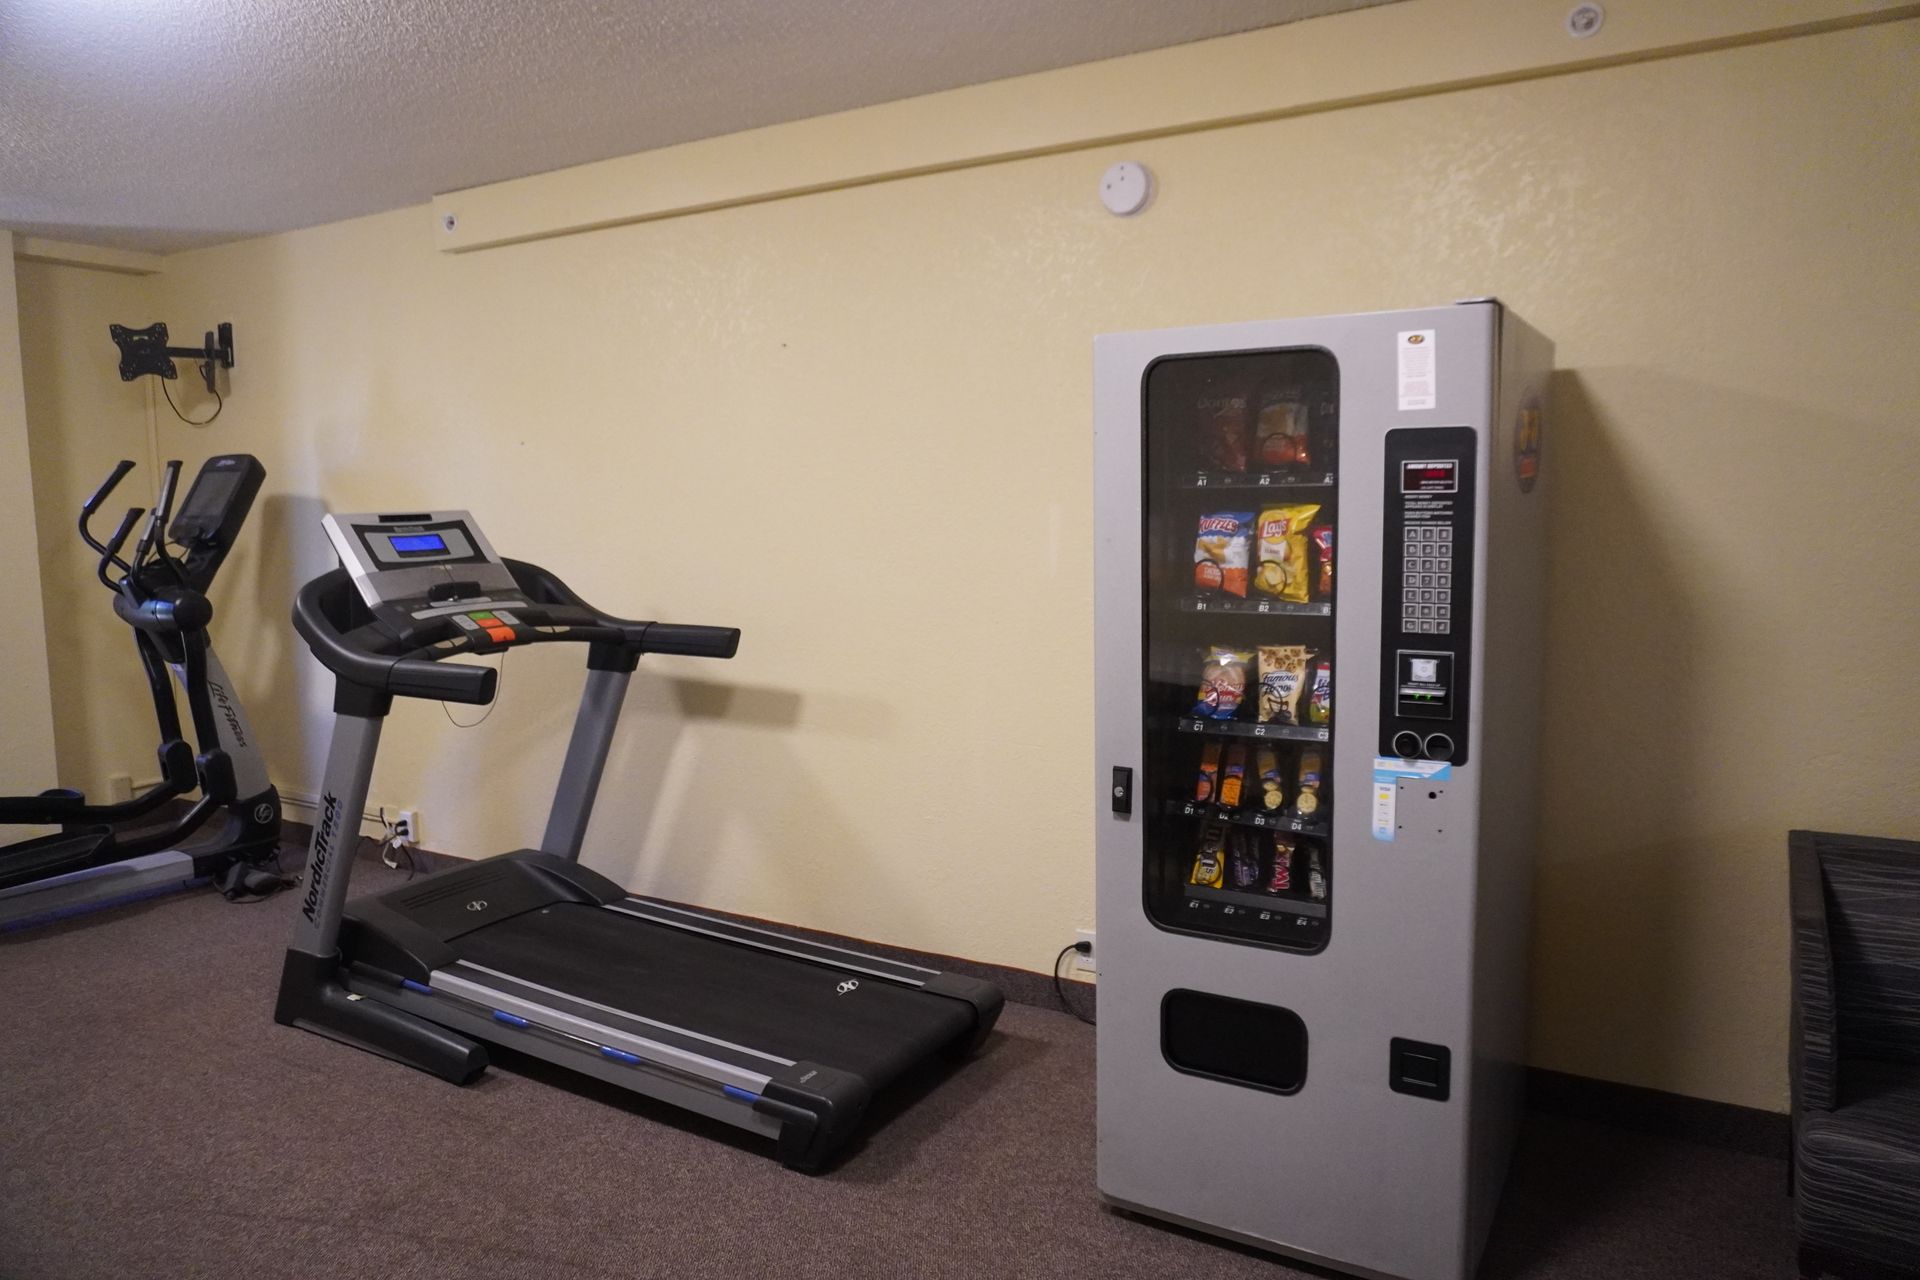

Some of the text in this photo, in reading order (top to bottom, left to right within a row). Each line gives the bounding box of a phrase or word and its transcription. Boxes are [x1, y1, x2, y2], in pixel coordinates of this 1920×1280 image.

[1197, 479, 1207, 487] A1
[1263, 520, 1288, 537] Lay's
[1196, 603, 1207, 611] B1
[1258, 604, 1269, 612] B2
[1193, 724, 1329, 740] C1 C2 C3
[1184, 806, 1194, 815] D1
[1254, 817, 1265, 826] D3
[1291, 822, 1302, 831] D4
[302, 791, 338, 923] NordicTrack
[1296, 918, 1308, 926] E4
